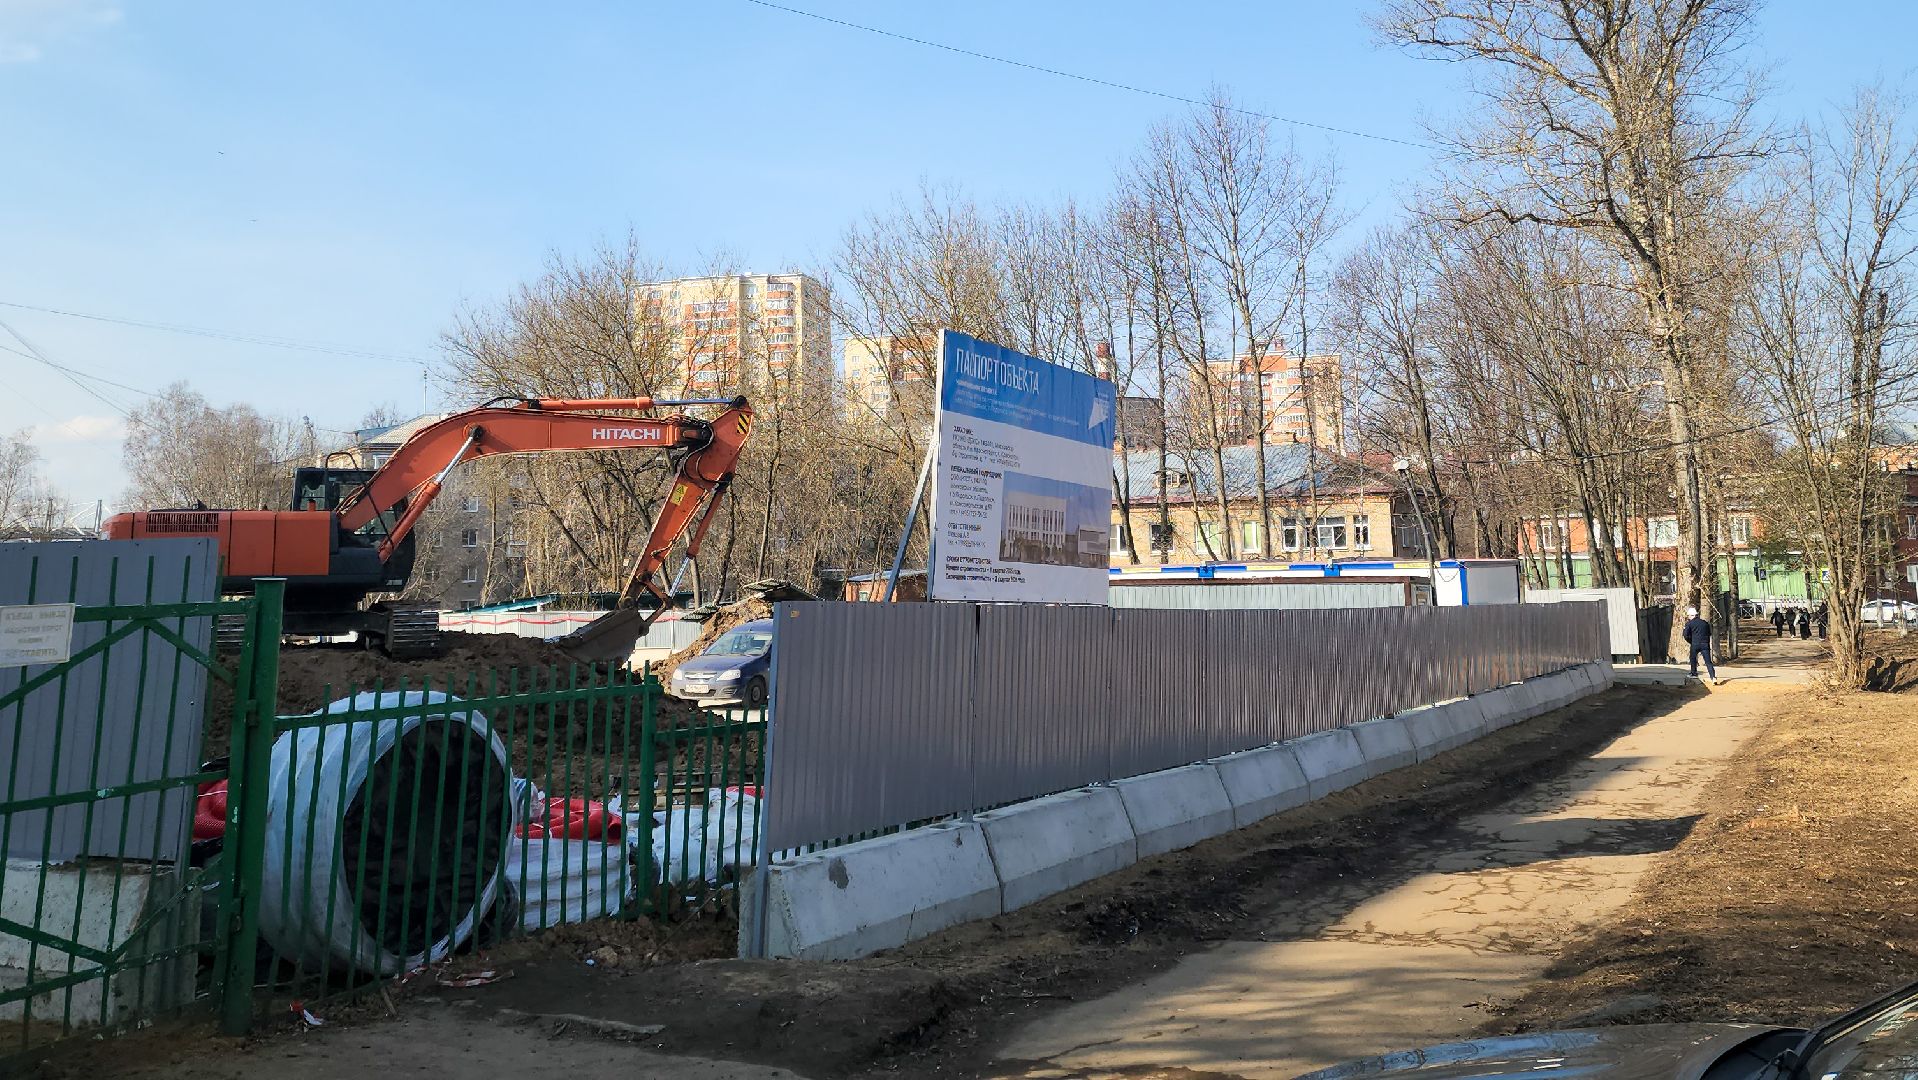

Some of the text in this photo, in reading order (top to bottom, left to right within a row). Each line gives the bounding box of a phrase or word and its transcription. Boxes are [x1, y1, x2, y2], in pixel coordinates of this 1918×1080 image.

[956, 348, 998, 384] ПАСПОРТ
[1000, 361, 1040, 395] ОБЪЕКТА
[592, 428, 660, 440] HITACHI
